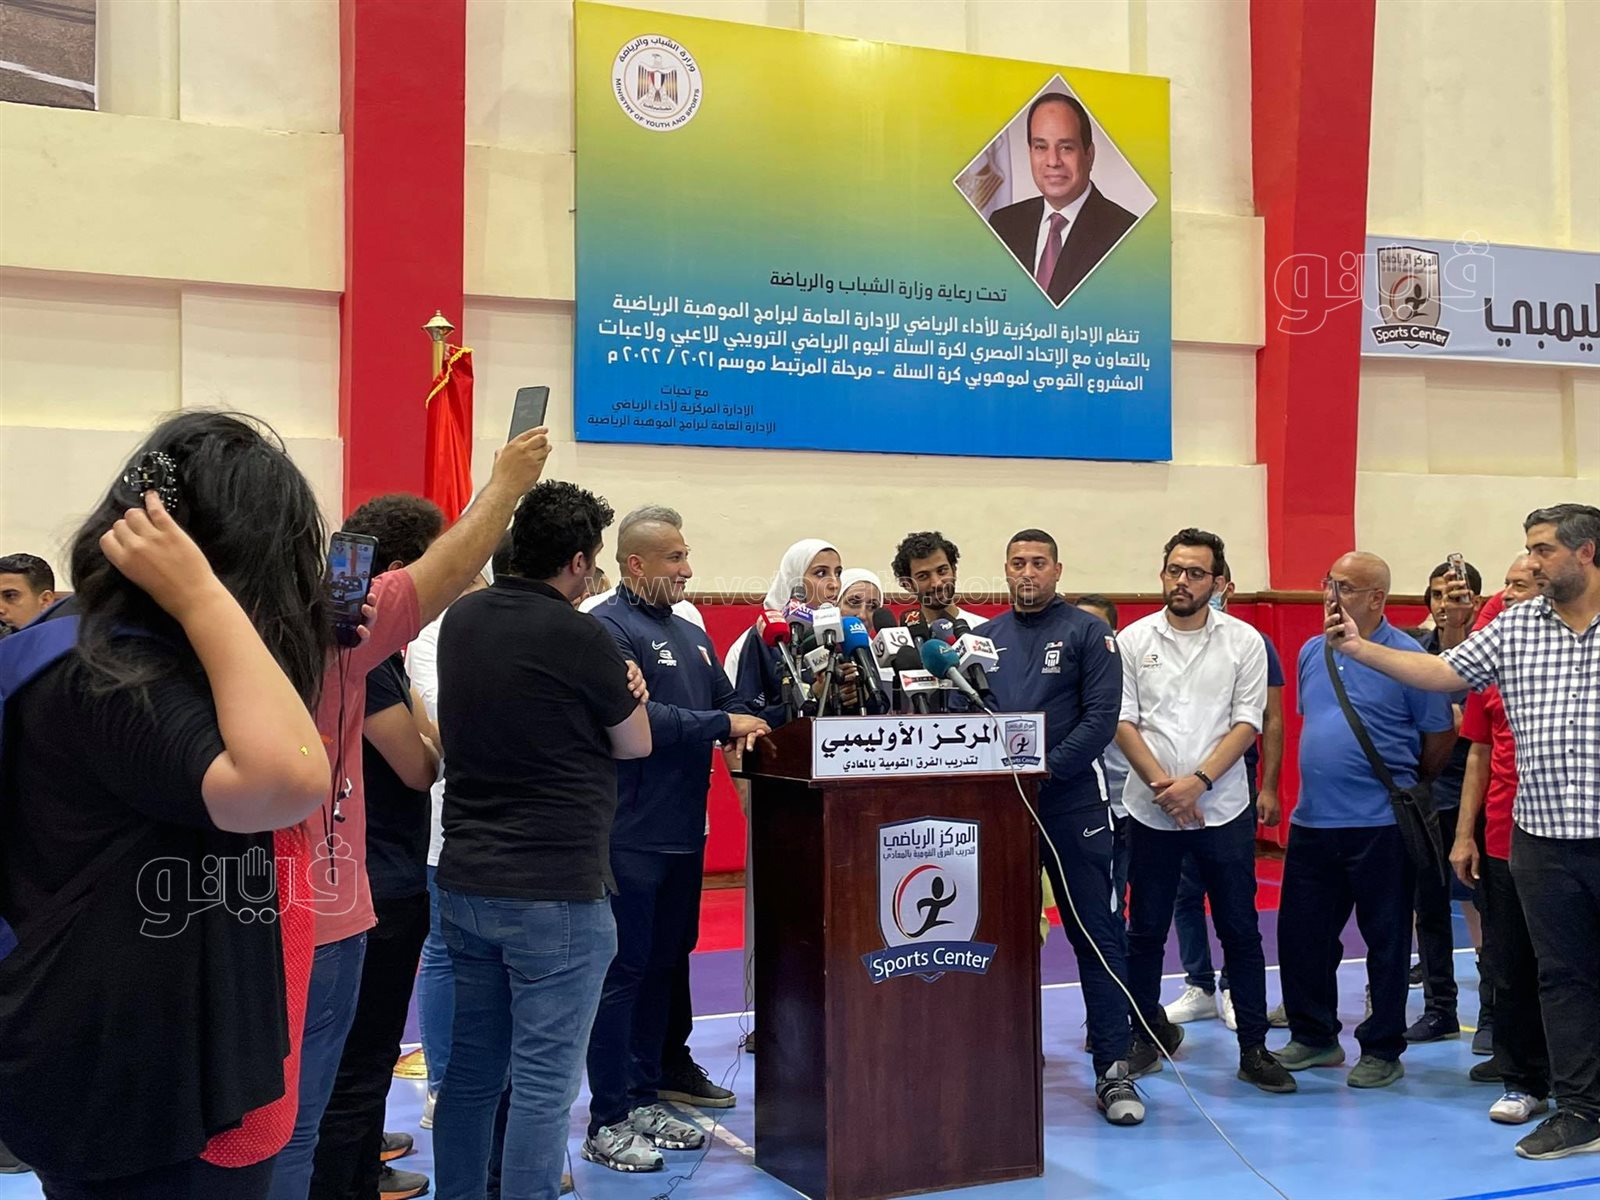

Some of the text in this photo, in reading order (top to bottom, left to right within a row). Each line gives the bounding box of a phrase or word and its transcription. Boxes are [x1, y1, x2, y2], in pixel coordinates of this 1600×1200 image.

[619, 38, 696, 72] وزارة الشباب والرياضة
[615, 78, 634, 114] MINISTRY
[634, 113, 645, 121] OF
[646, 119, 670, 128] YOUTH
[672, 115, 687, 126] AND
[687, 88, 700, 116] SPORTS
[770, 270, 1007, 303] تحت رعاية وزارة الشباب والرياضة
[612, 293, 1140, 347] تنظم الإدارة المركزية للأداء الرياضي للإدارة العامة لبرامج الموهبة الرياضية
[1375, 326, 1447, 343] Sports Center
[598, 318, 1151, 371] بالتعاون مع الإتحاد المصري لكرة السلة اليوم الرياضي الترويجي للاعبي ولاعبات
[607, 350, 619, 364] م
[622, 345, 661, 364] ٢٠٢٢
[666, 348, 676, 365] /
[680, 350, 713, 367] ٢٠٢١
[718, 357, 766, 373] موسم
[770, 354, 827, 376] المرتبط
[831, 357, 873, 380] مرحلة
[892, 363, 934, 380] السلة
[937, 366, 961, 382] كرة
[965, 370, 1030, 390] لموهوبي
[1033, 373, 1084, 392] القومي
[1086, 376, 1144, 394] المشروع
[660, 384, 709, 400] مع تحيات
[611, 399, 651, 412] الرياضي
[680, 402, 720, 414] المركزية
[722, 403, 754, 416] الإدارة
[587, 414, 776, 435] الإدارة العامة لبرامج الموهبة الرياضية
[820, 720, 998, 759] المركز الأوليمبي
[842, 755, 978, 772] لتدريب الفرق القومية بالمعادي
[883, 825, 976, 850] المركز الرياضي
[872, 947, 990, 978] Sports Center
